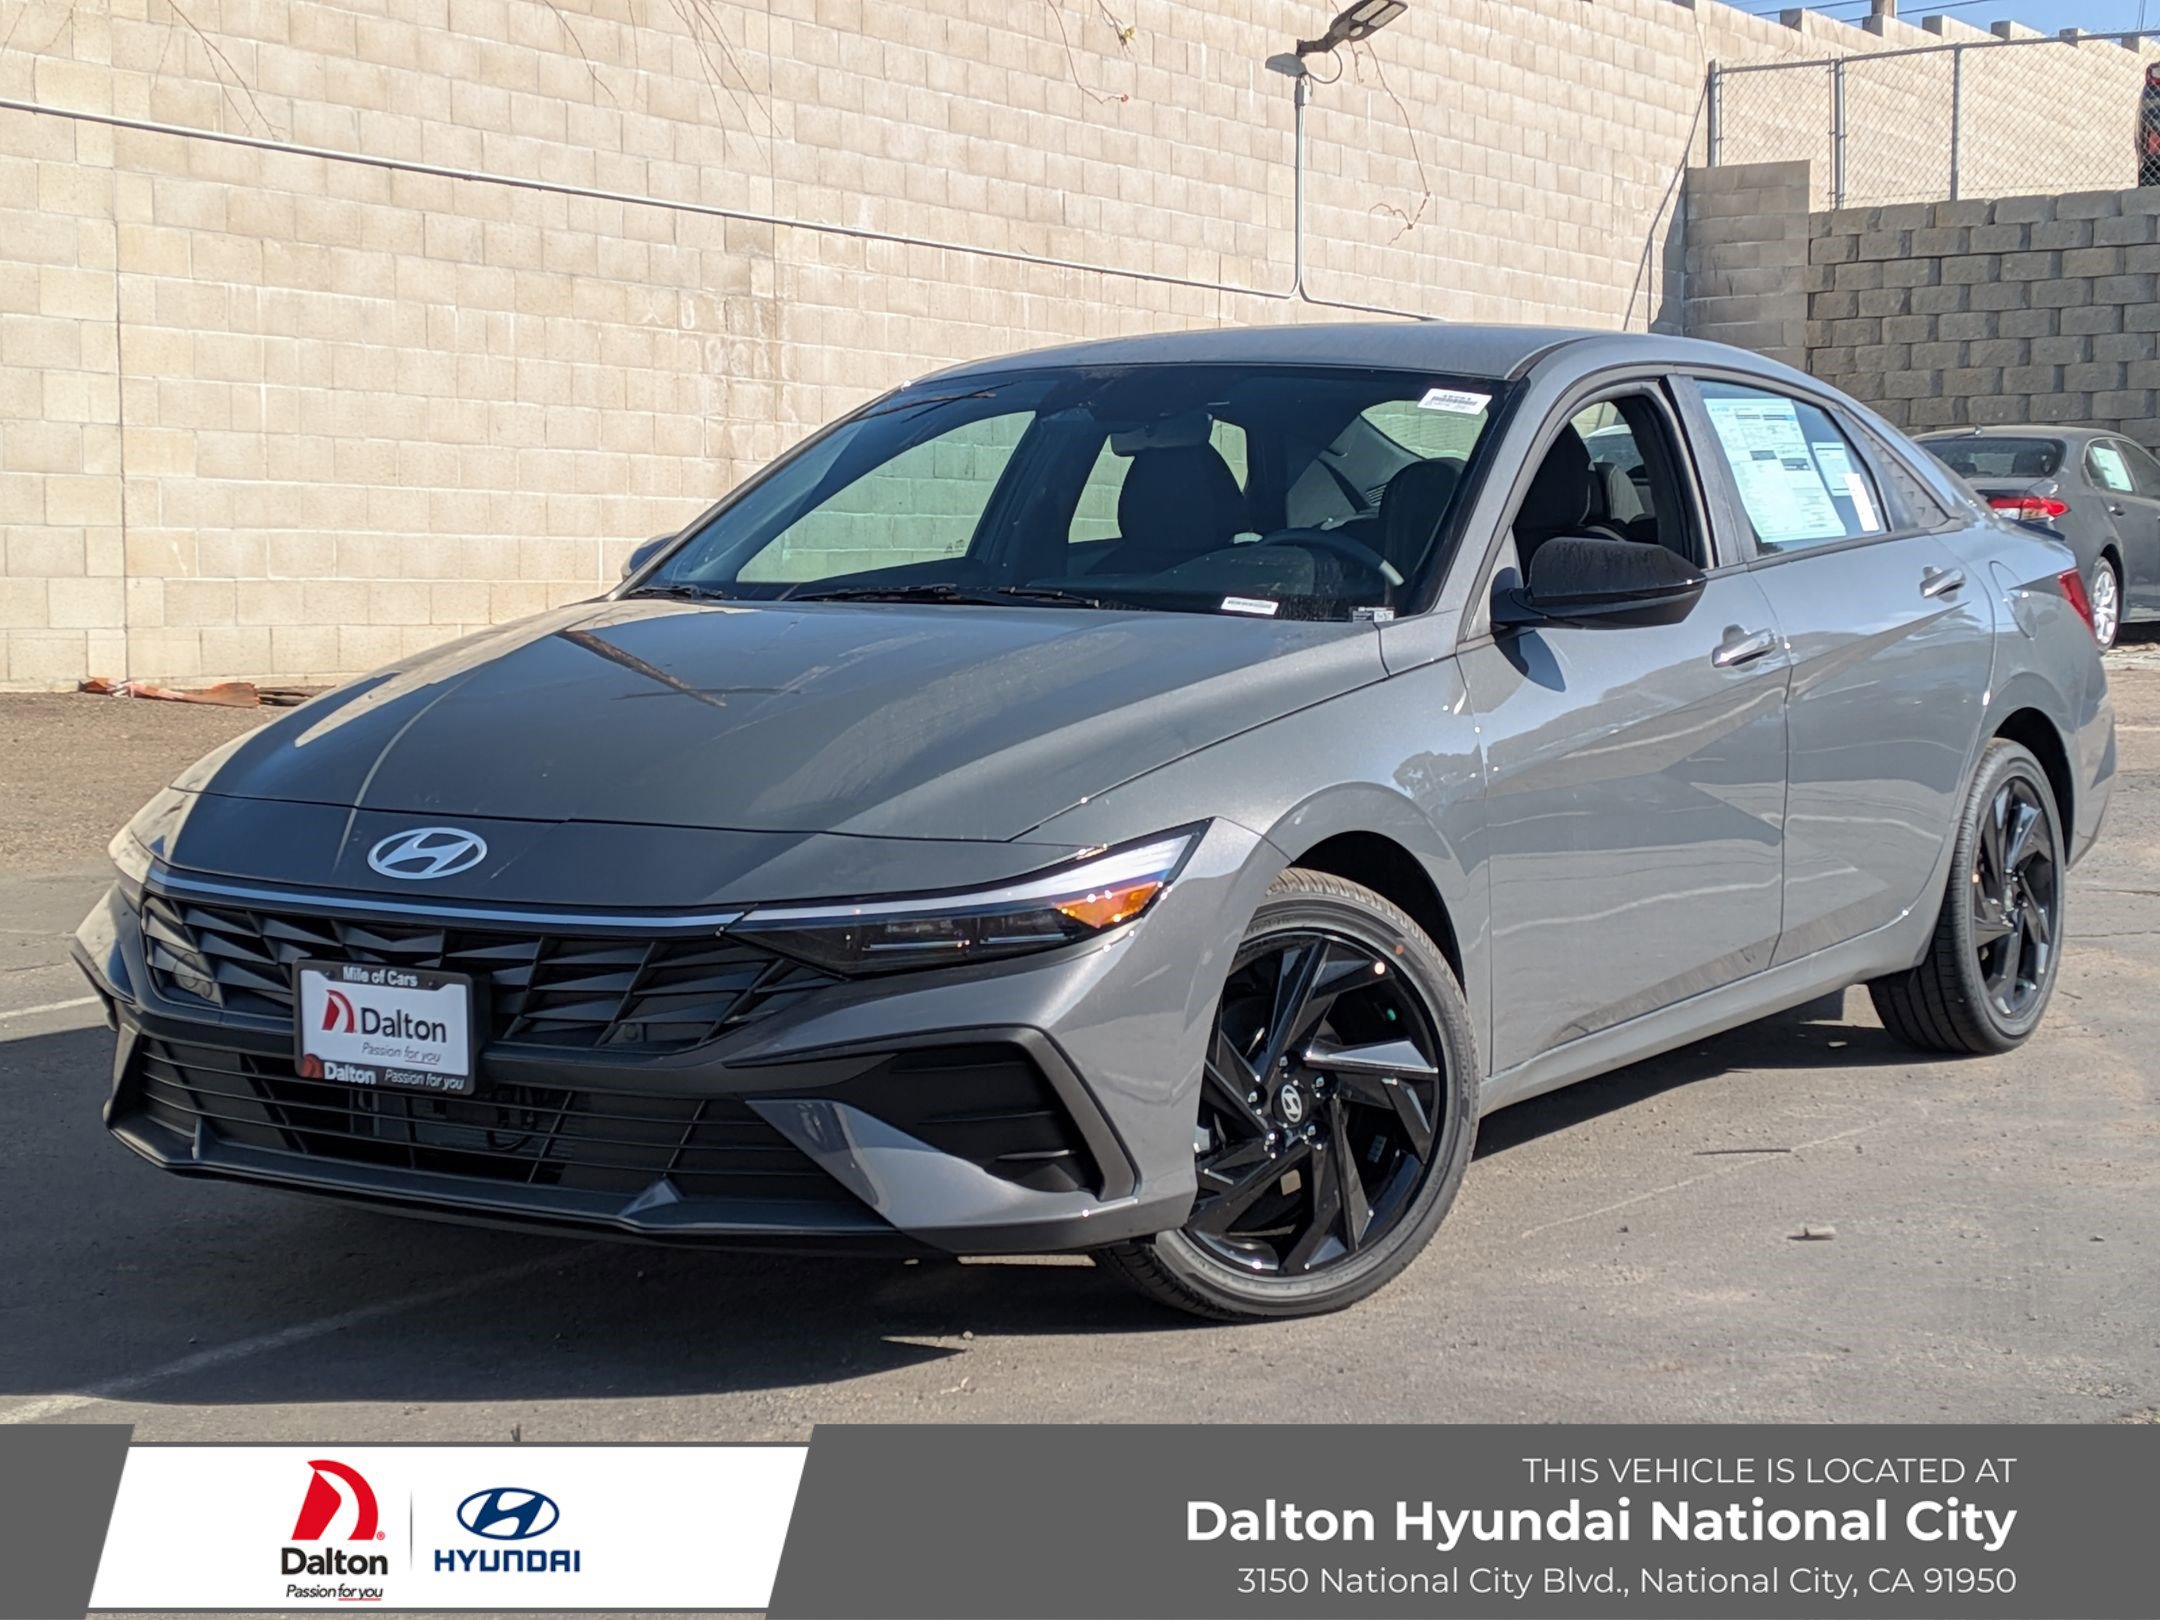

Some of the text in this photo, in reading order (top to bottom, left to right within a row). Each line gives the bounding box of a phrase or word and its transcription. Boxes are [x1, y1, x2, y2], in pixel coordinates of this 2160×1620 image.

[342, 965, 418, 987] Mile of Cars
[361, 1007, 447, 1043] Dalton
[361, 1041, 441, 1064] Passion for you
[324, 1061, 465, 1091] Dalton Passion for you
